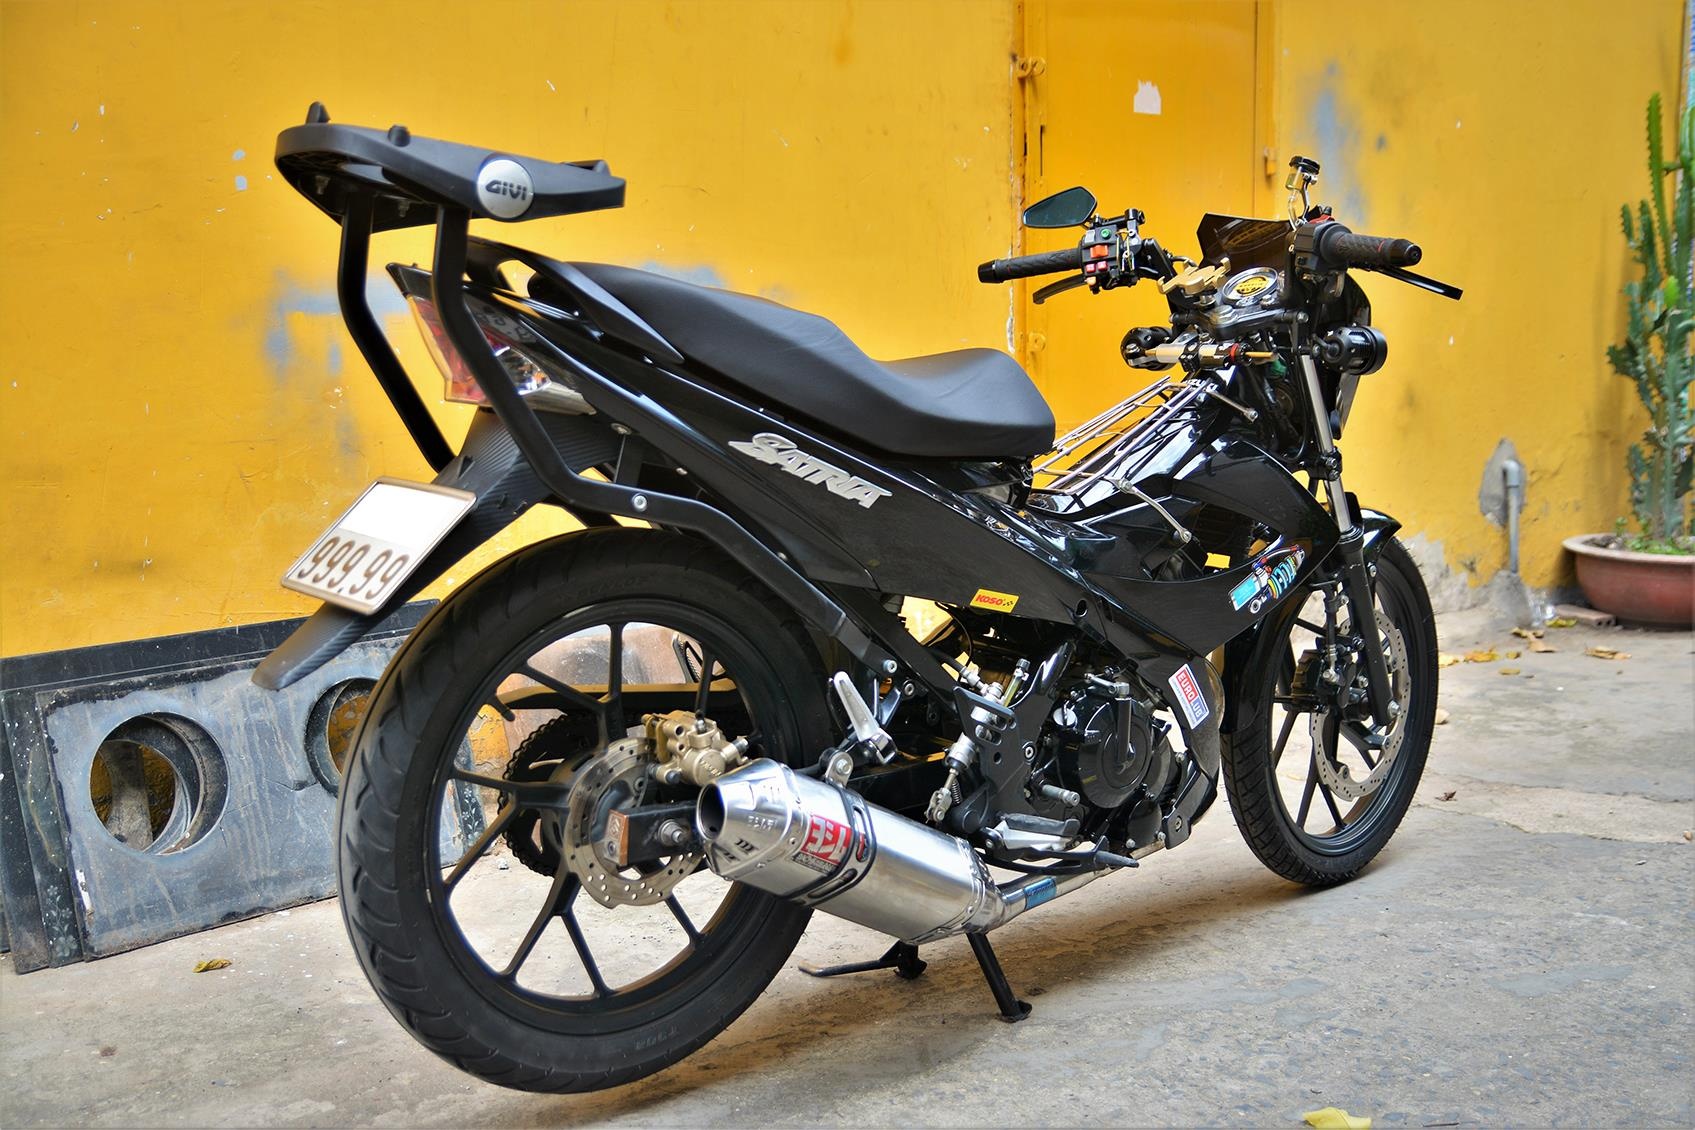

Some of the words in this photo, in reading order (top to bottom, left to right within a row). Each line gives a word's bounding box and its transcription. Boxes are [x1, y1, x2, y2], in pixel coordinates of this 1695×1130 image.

[485, 179, 527, 201] GIVI
[728, 432, 893, 509] SATRIA
[976, 594, 1004, 606] KOSO
